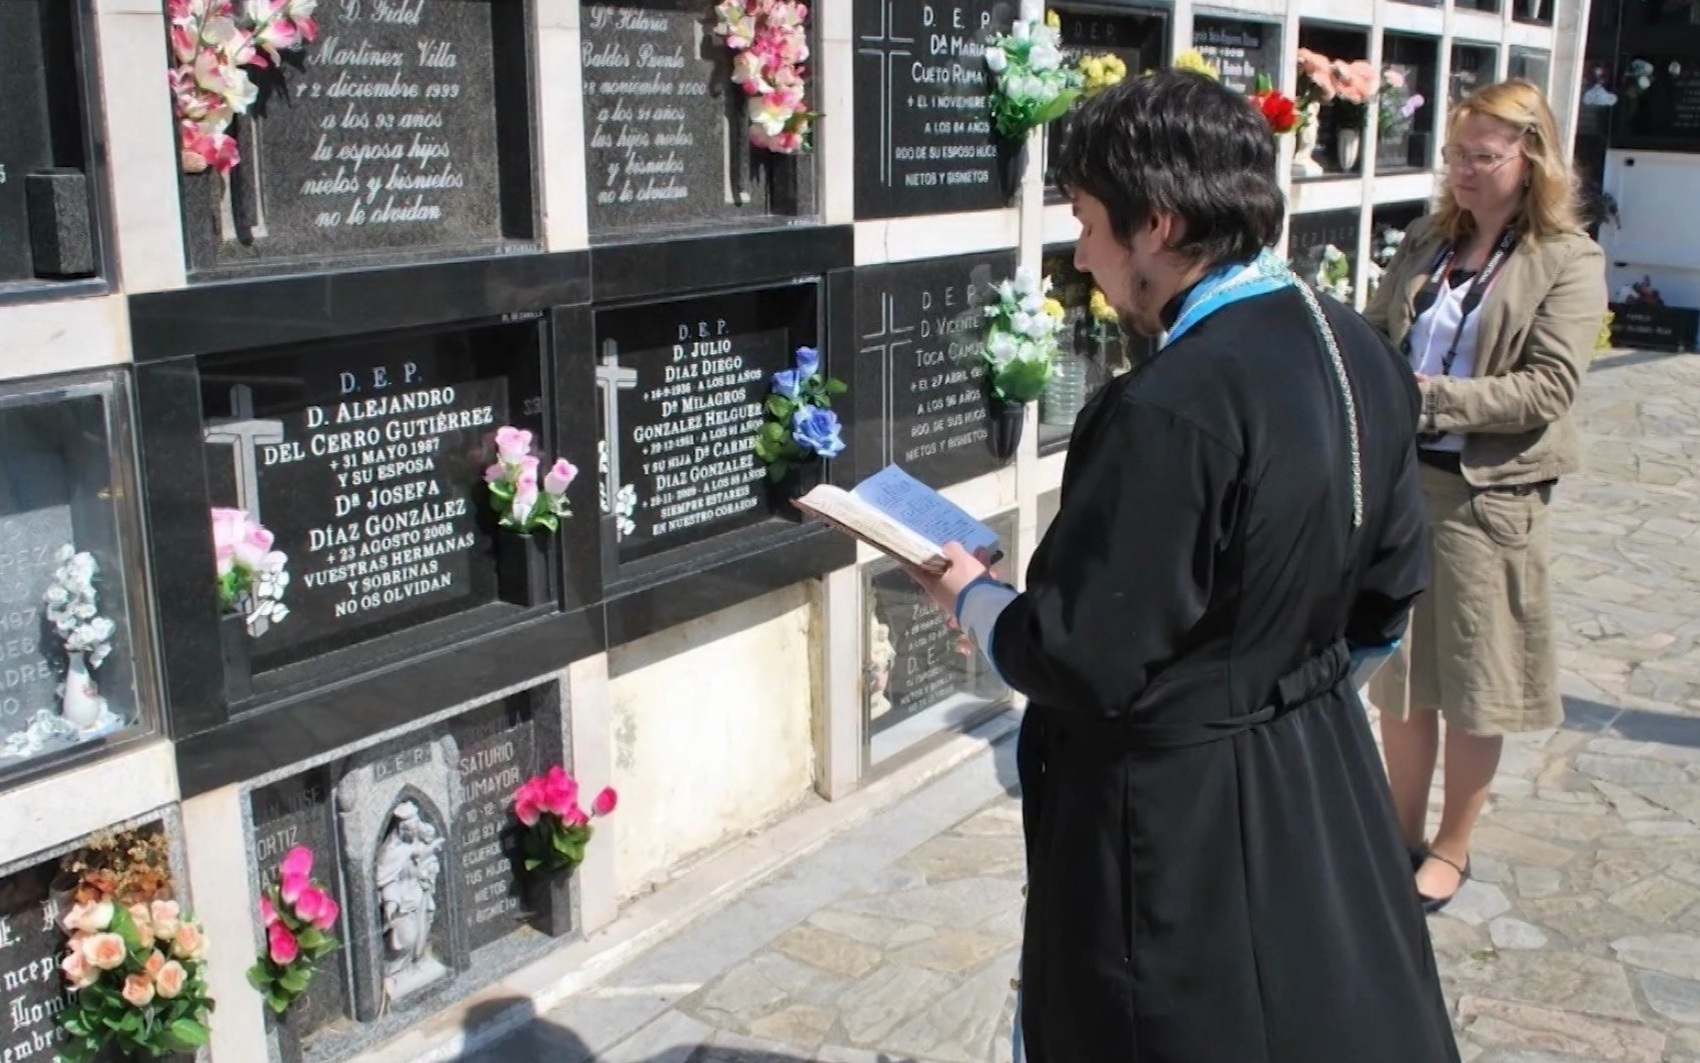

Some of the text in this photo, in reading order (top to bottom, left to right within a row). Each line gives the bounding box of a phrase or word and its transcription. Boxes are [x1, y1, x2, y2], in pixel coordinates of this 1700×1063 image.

[417, 39, 458, 68] Villa
[326, 70, 419, 98] diciembre
[341, 102, 369, 128] los
[336, 143, 404, 172] esposa
[407, 132, 450, 169] hijos
[300, 163, 464, 205] nietos y bisnietos
[314, 211, 341, 228] no
[369, 194, 441, 223] olvidan
[678, 324, 691, 341] D.
[717, 318, 729, 335] P.
[673, 339, 732, 362] D. JULIO
[702, 355, 742, 375] DIEGO
[340, 362, 422, 394] D. E. P.
[306, 386, 455, 428] D. ALEJANDRO
[682, 387, 746, 413] MILAGROS
[633, 415, 702, 443] GONZALEZ
[264, 441, 306, 466] DEL
[310, 426, 380, 456] CERRO
[362, 442, 407, 466] MAYO
[411, 437, 440, 458] 1987
[337, 458, 434, 488] Y SU ESPOSA
[690, 454, 754, 482] GONZALEZ
[367, 479, 440, 510] JOSEFA
[668, 510, 714, 532] NUESTRO
[359, 531, 421, 559] AGOSTO
[304, 532, 475, 589] VUESTRAS HERMANAS
[348, 560, 439, 596] Y SOBRINAS
[335, 572, 452, 618] NO OS OLVIDAN
[257, 825, 299, 861] ORTIZ
